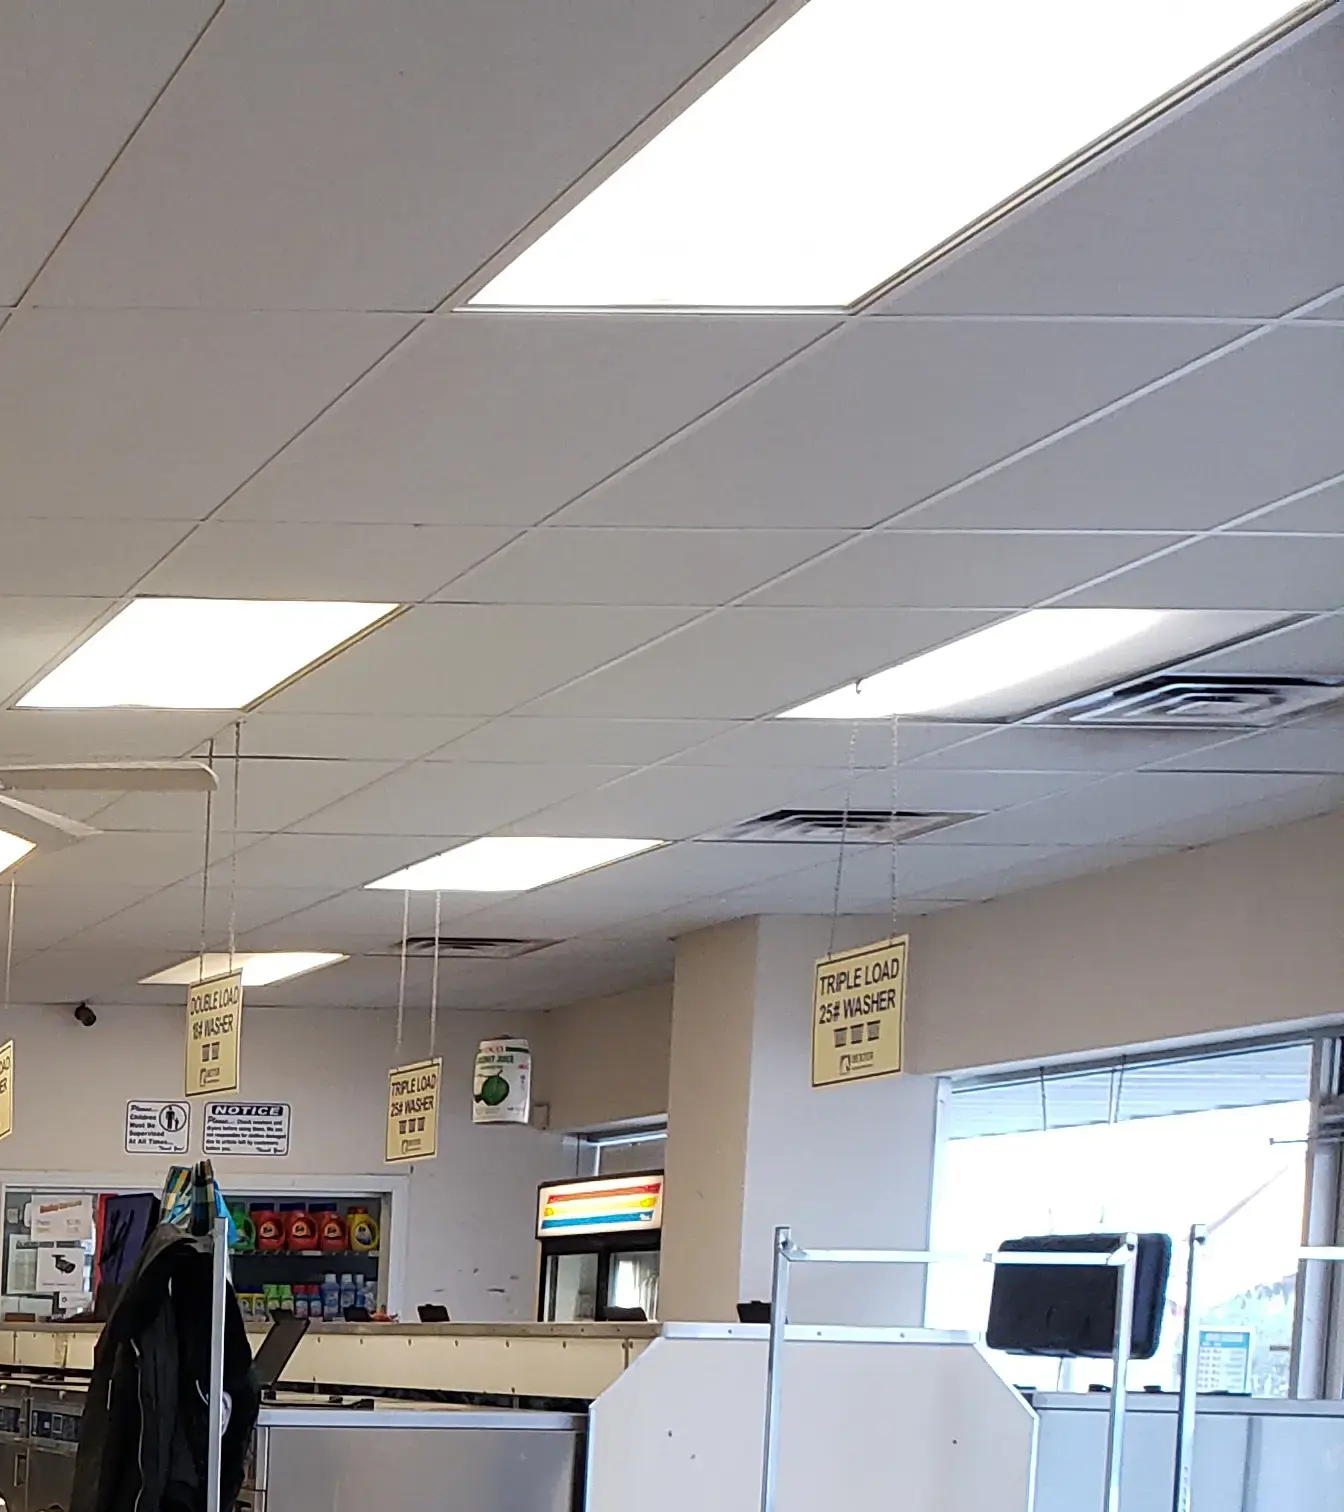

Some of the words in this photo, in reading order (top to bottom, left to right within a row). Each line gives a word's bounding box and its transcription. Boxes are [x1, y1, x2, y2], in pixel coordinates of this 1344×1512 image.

[820, 967, 862, 996] TRIPLE
[865, 957, 900, 987] LOAD
[190, 991, 218, 1016] DOUBLE
[219, 985, 239, 1009] LOAD
[818, 1001, 840, 1025] 25#
[843, 988, 896, 1019] WASHER
[204, 1013, 234, 1037] WASHER
[391, 1077, 416, 1097] TRIPLE
[417, 1073, 438, 1092] LOAD
[214, 1106, 280, 1116] NOTICE
[404, 1095, 434, 1116] WASHER
